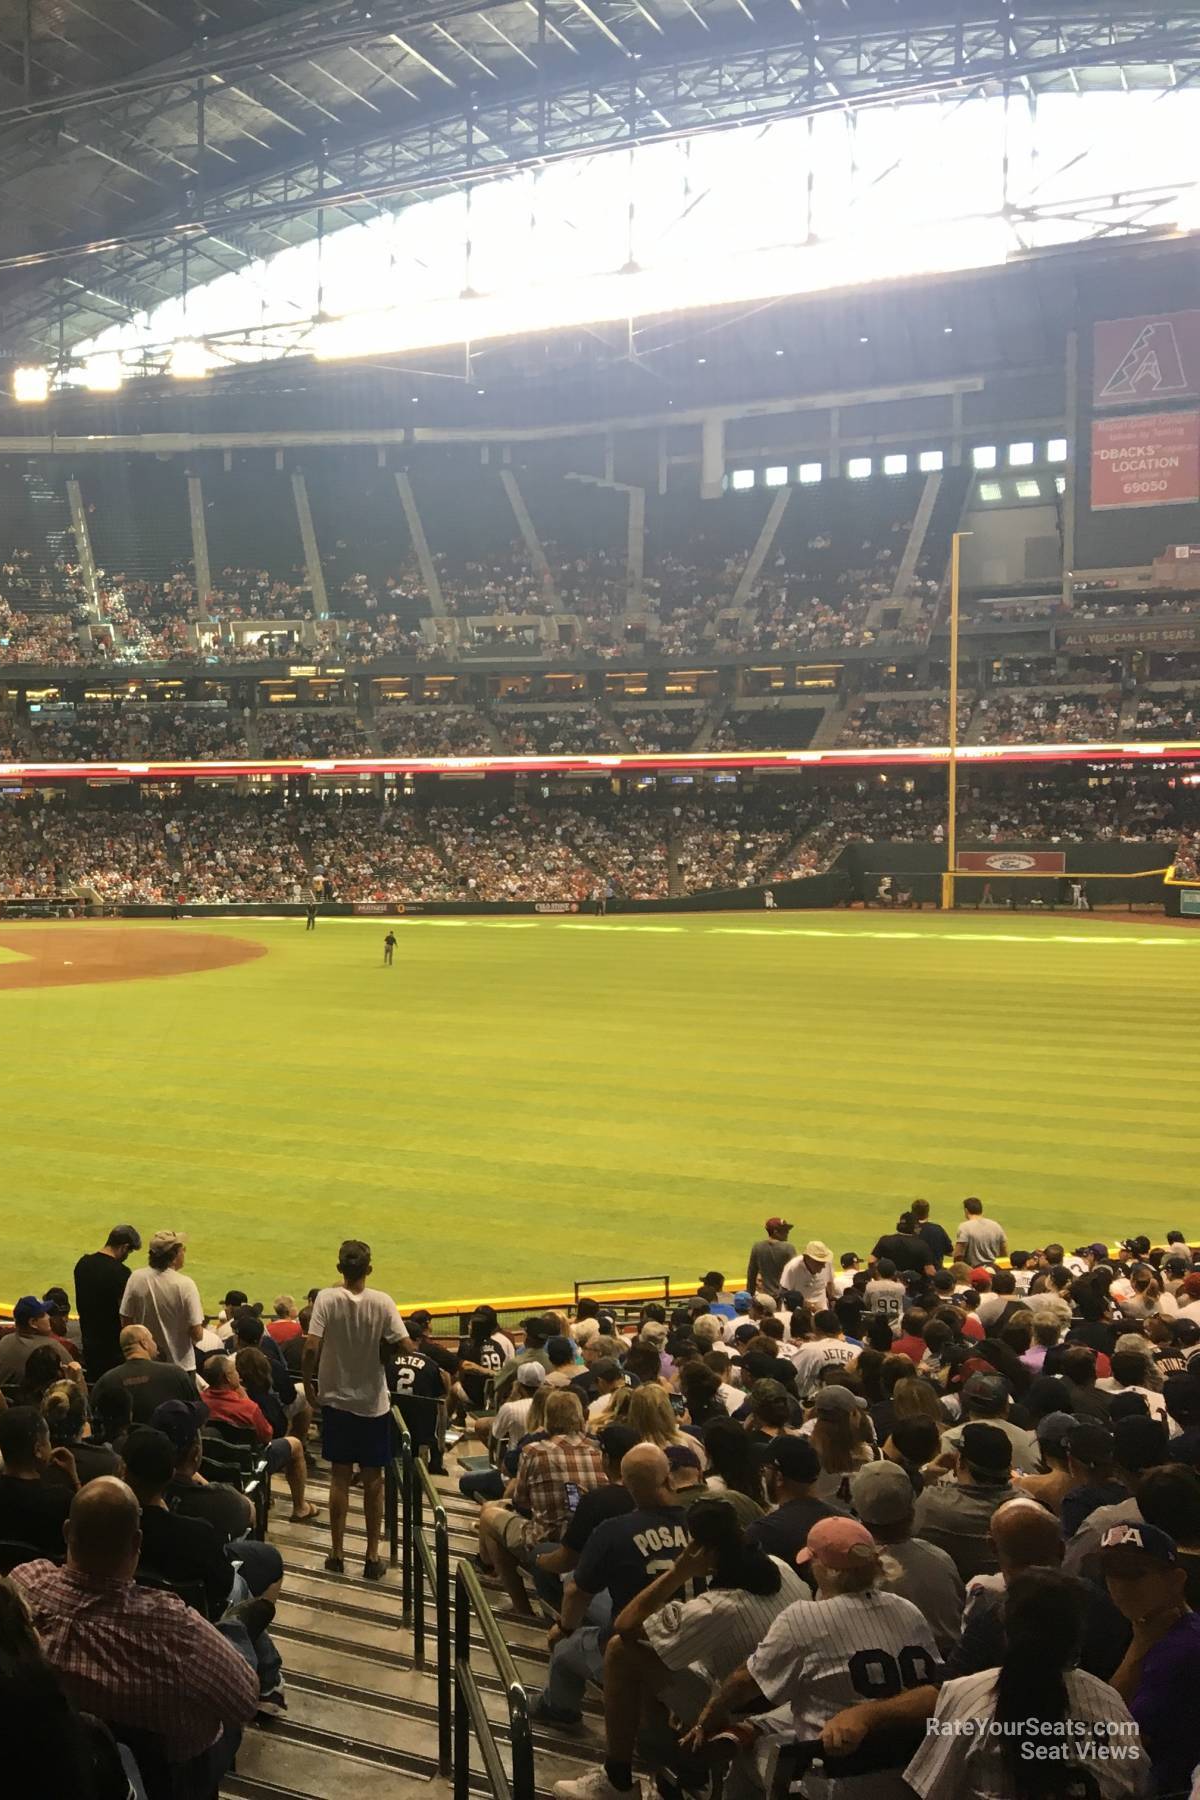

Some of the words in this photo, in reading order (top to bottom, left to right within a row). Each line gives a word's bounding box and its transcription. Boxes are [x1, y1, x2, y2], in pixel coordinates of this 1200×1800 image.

[1112, 456, 1179, 473] LOCATION
[1123, 480, 1168, 494] 69050
[1161, 630, 1196, 642] SEATS
[394, 1355, 426, 1370] JETER
[480, 1353, 501, 1371] 99
[824, 1349, 854, 1361] JETER
[396, 1367, 415, 1394] 2
[633, 1525, 694, 1557] POSA
